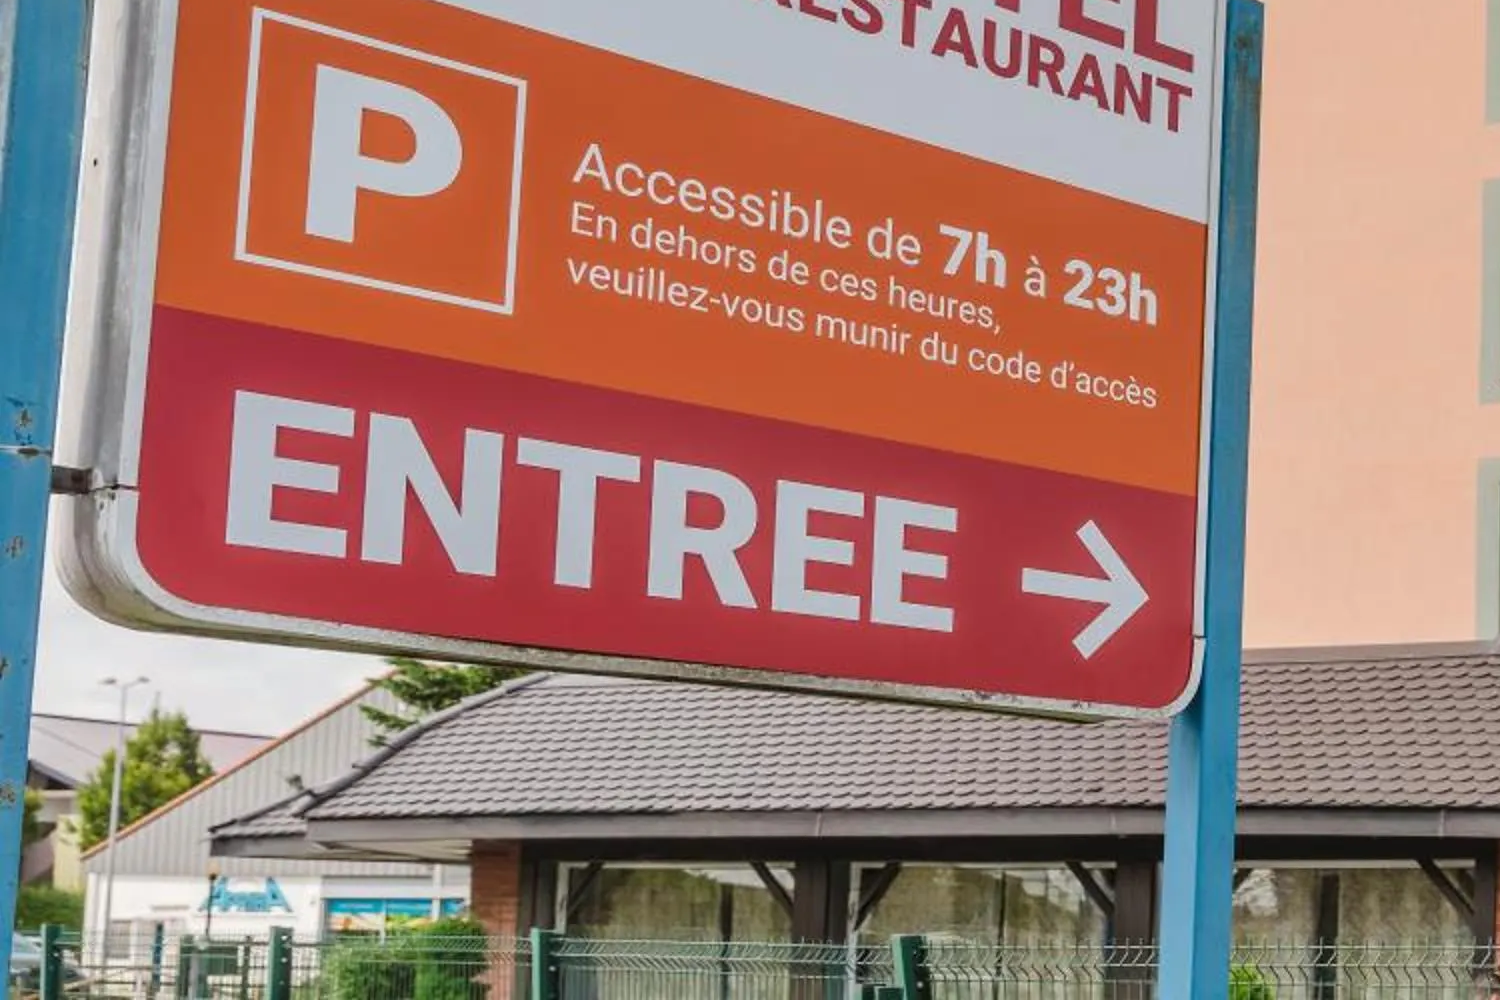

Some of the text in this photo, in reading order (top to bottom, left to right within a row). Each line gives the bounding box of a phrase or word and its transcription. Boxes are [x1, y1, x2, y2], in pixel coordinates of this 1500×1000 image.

[305, 62, 463, 244] P
[572, 143, 1158, 326] Accessible de 7h à 23h
[567, 258, 1157, 409] veuillez-vous munir du code d'accès
[571, 200, 1001, 336] En dehors de ces heures,
[224, 388, 960, 633] ENTREE
